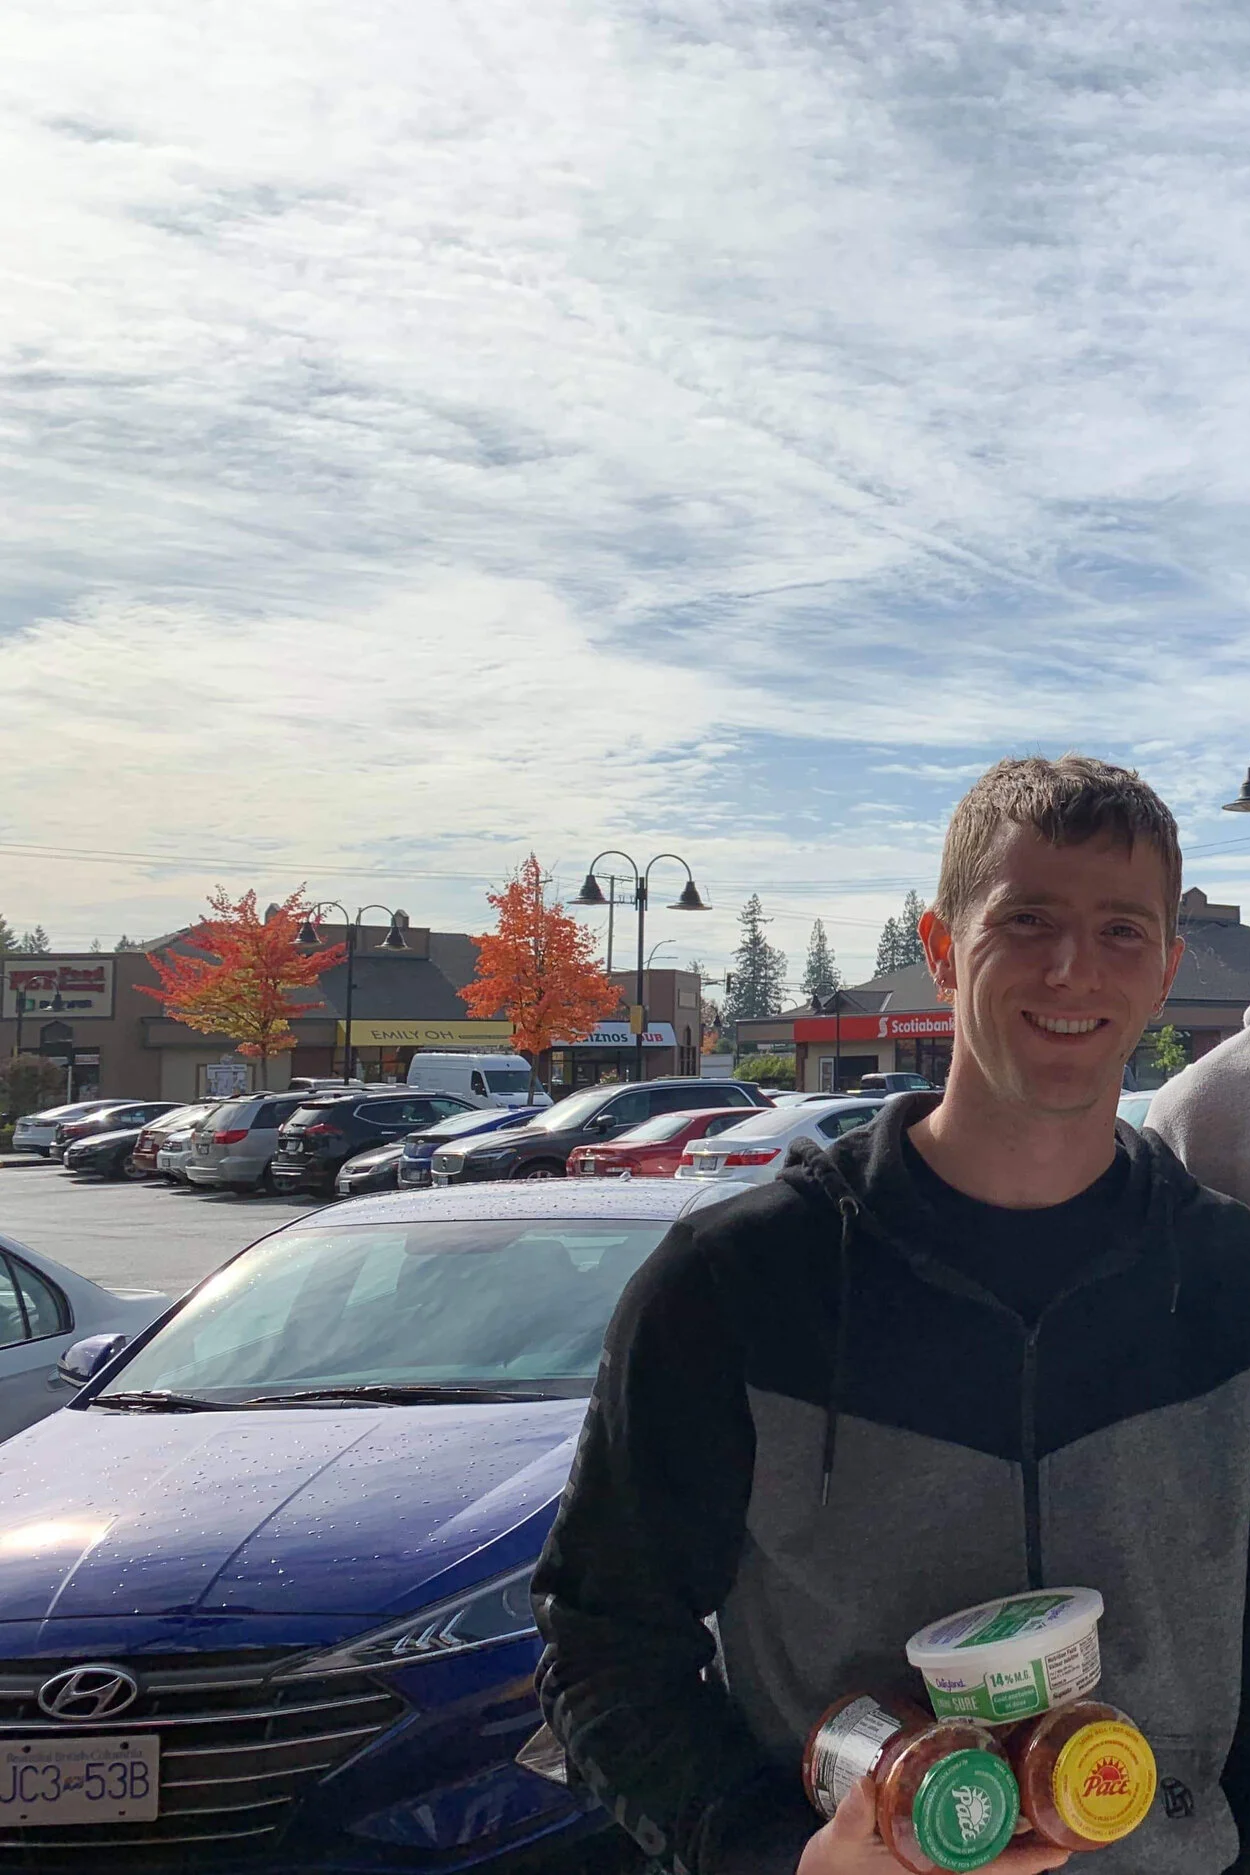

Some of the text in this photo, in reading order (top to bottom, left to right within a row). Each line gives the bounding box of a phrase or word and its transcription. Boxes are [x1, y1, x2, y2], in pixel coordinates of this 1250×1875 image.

[892, 1017, 955, 1033] Scotiabank
[371, 1030, 420, 1040] EMILY
[425, 1030, 454, 1040] OH
[952, 1696, 978, 1711] SURE
[84, 1761, 149, 1800] 53B
